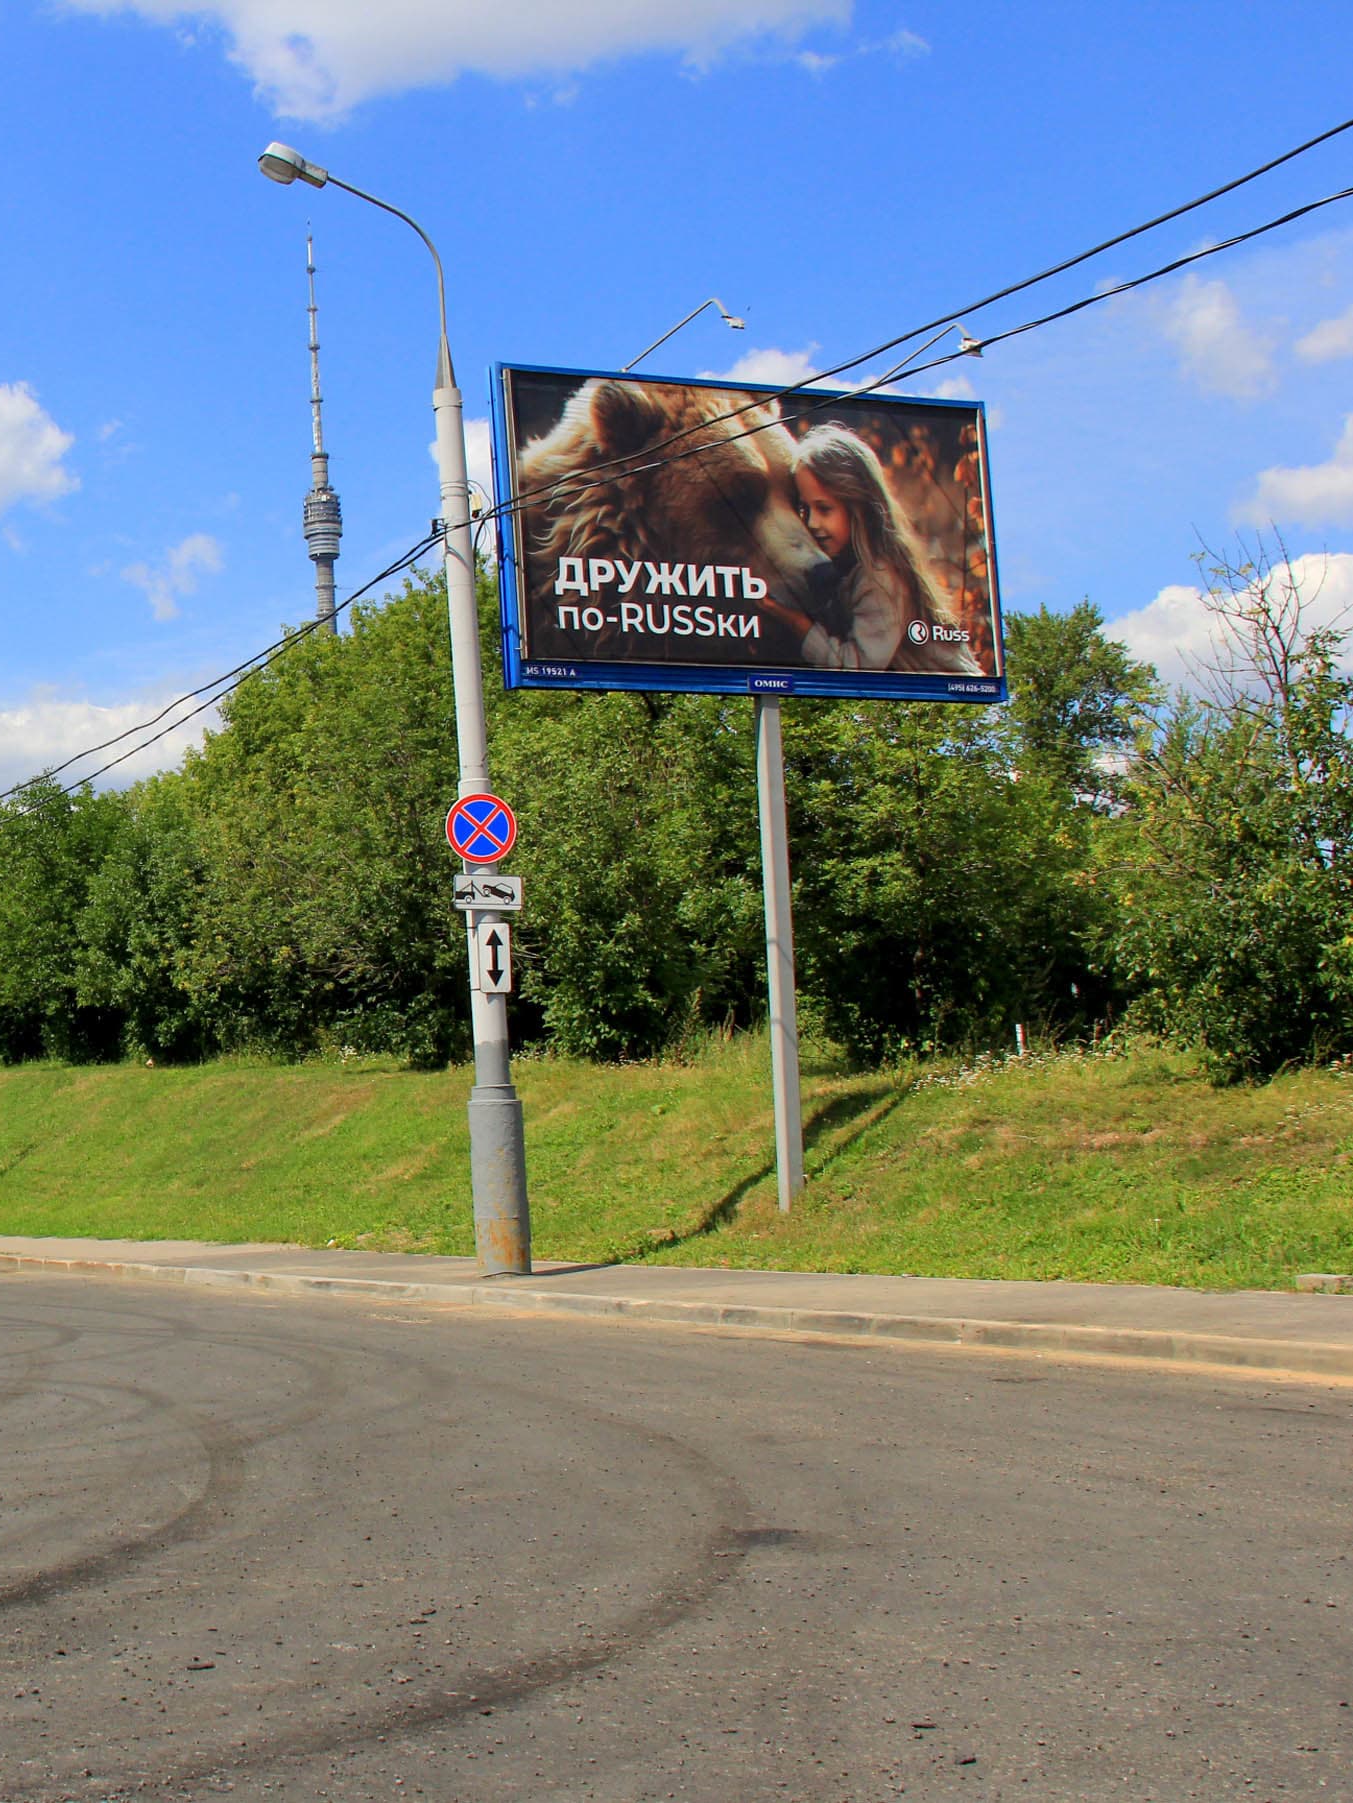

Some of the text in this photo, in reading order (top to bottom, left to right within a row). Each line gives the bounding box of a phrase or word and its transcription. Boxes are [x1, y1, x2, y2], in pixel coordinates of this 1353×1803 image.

[554, 556, 768, 599] ДРУЖИТЬ
[557, 602, 761, 638] по-RUSSки
[932, 625, 970, 642] Russ
[542, 667, 567, 676] 19521
[754, 679, 789, 689] ОМИС
